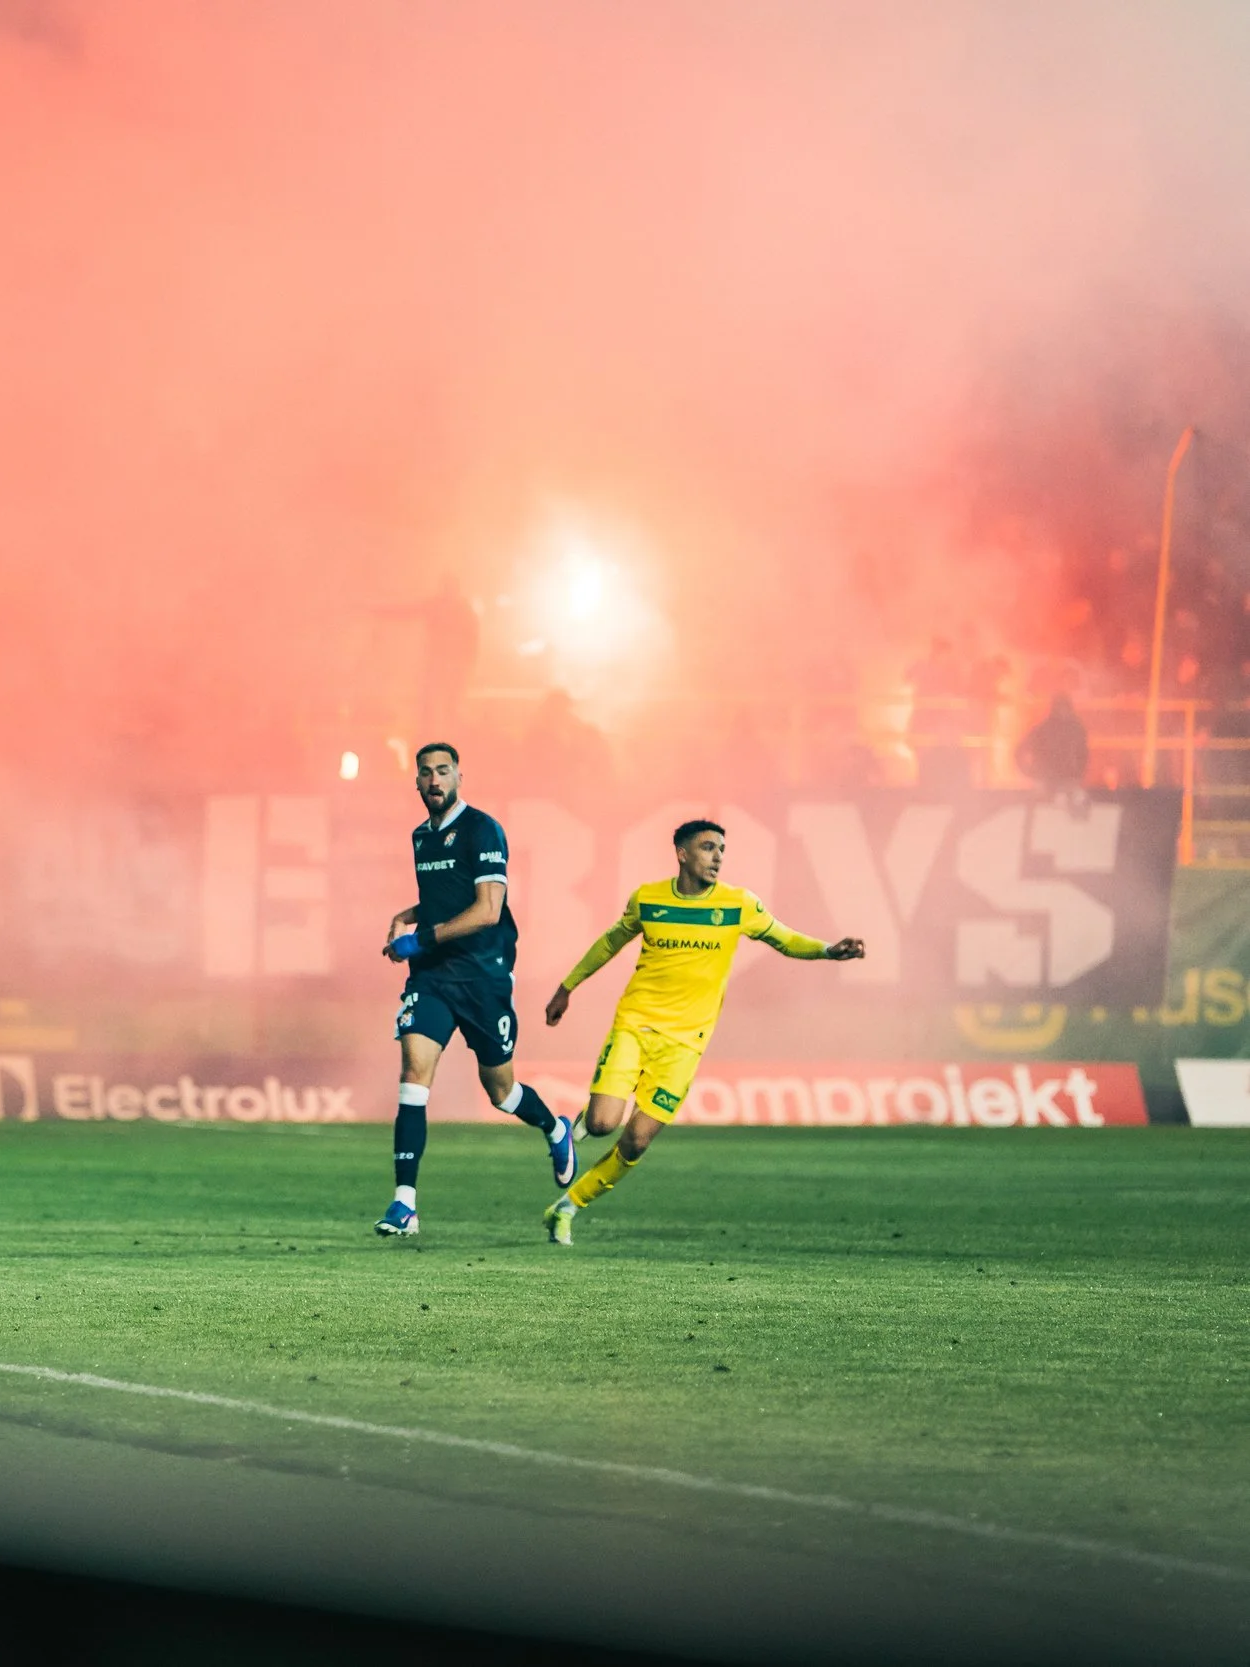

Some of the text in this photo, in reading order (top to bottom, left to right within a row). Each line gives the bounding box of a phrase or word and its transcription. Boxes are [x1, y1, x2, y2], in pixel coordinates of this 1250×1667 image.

[656, 938, 721, 950] GERMANIA
[497, 1015, 511, 1042] 9
[53, 1075, 356, 1120] Electrolux
